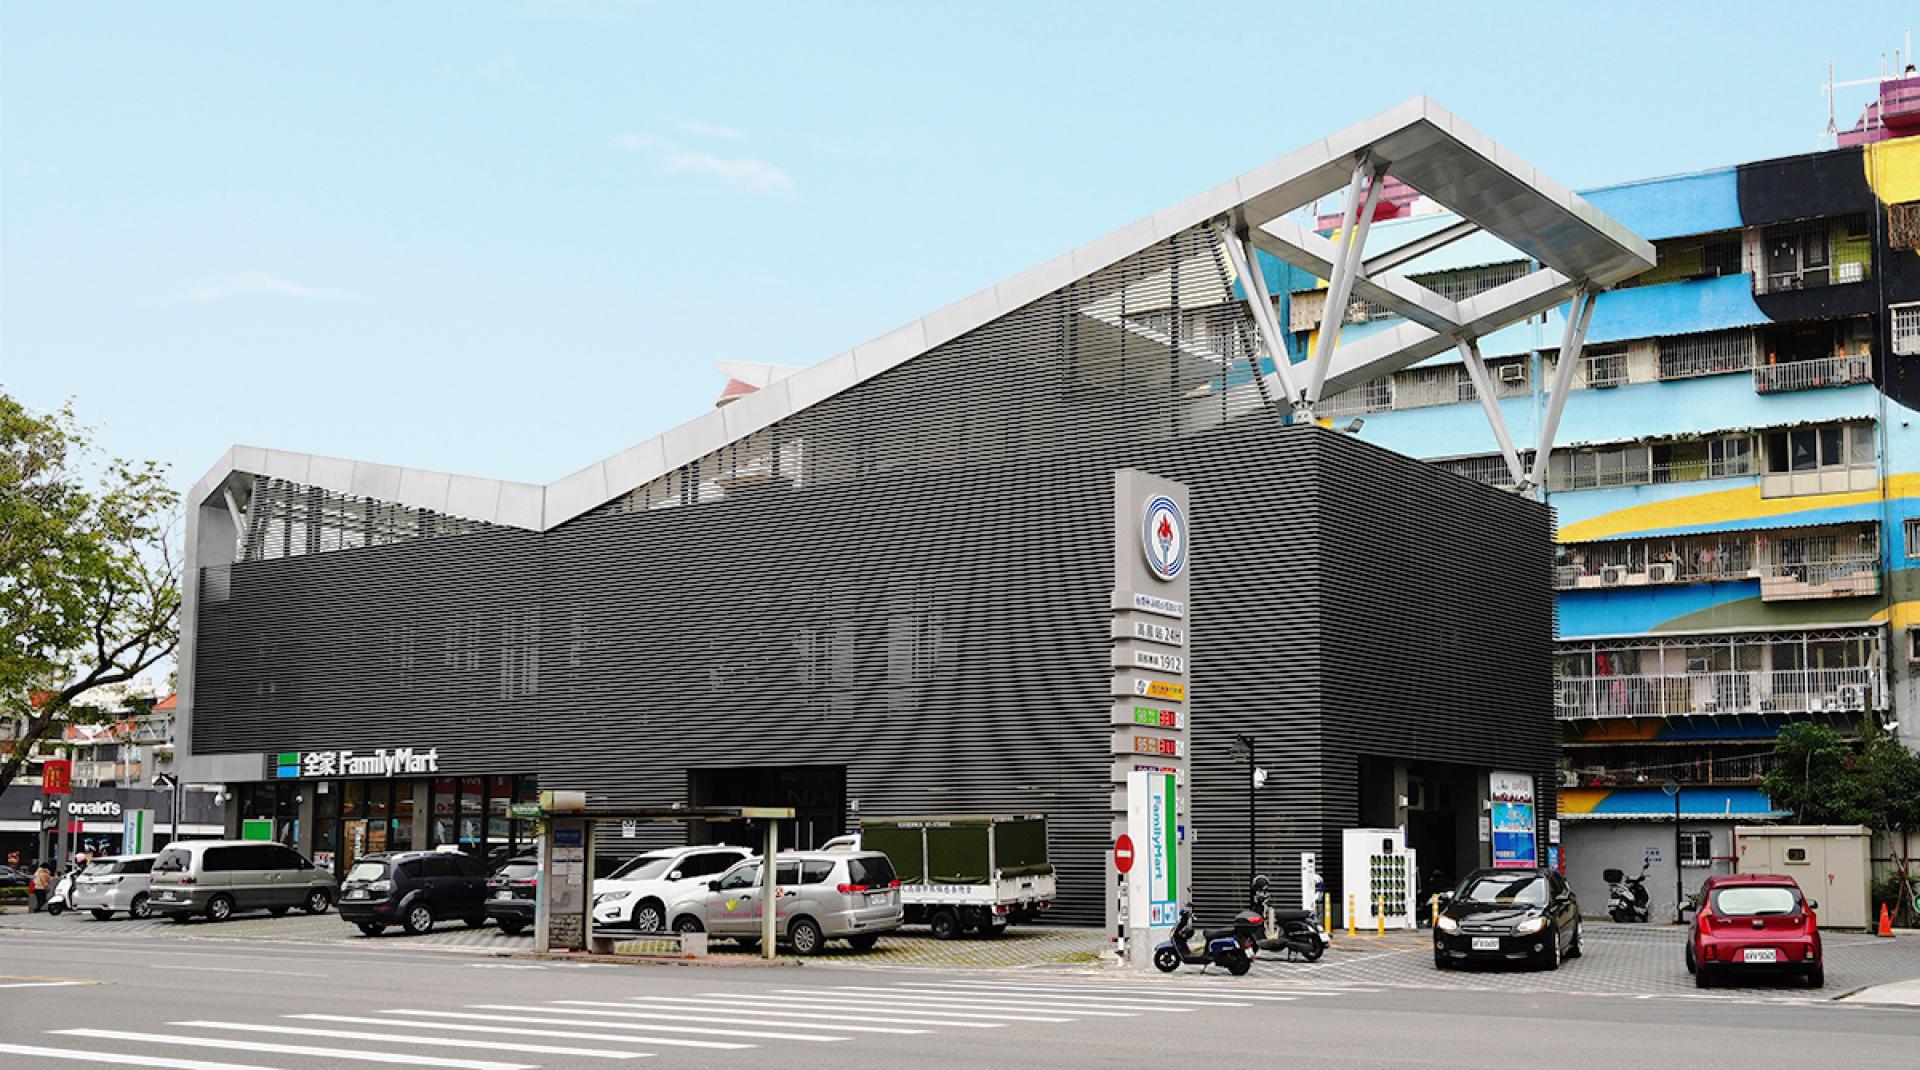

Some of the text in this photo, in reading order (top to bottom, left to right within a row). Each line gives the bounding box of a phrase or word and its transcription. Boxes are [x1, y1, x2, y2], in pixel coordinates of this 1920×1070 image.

[1160, 655, 1181, 671] 1912
[303, 747, 439, 777] 全家 FamilyMart
[32, 800, 121, 815] Monald's
[1153, 795, 1163, 881] FamilyMart
